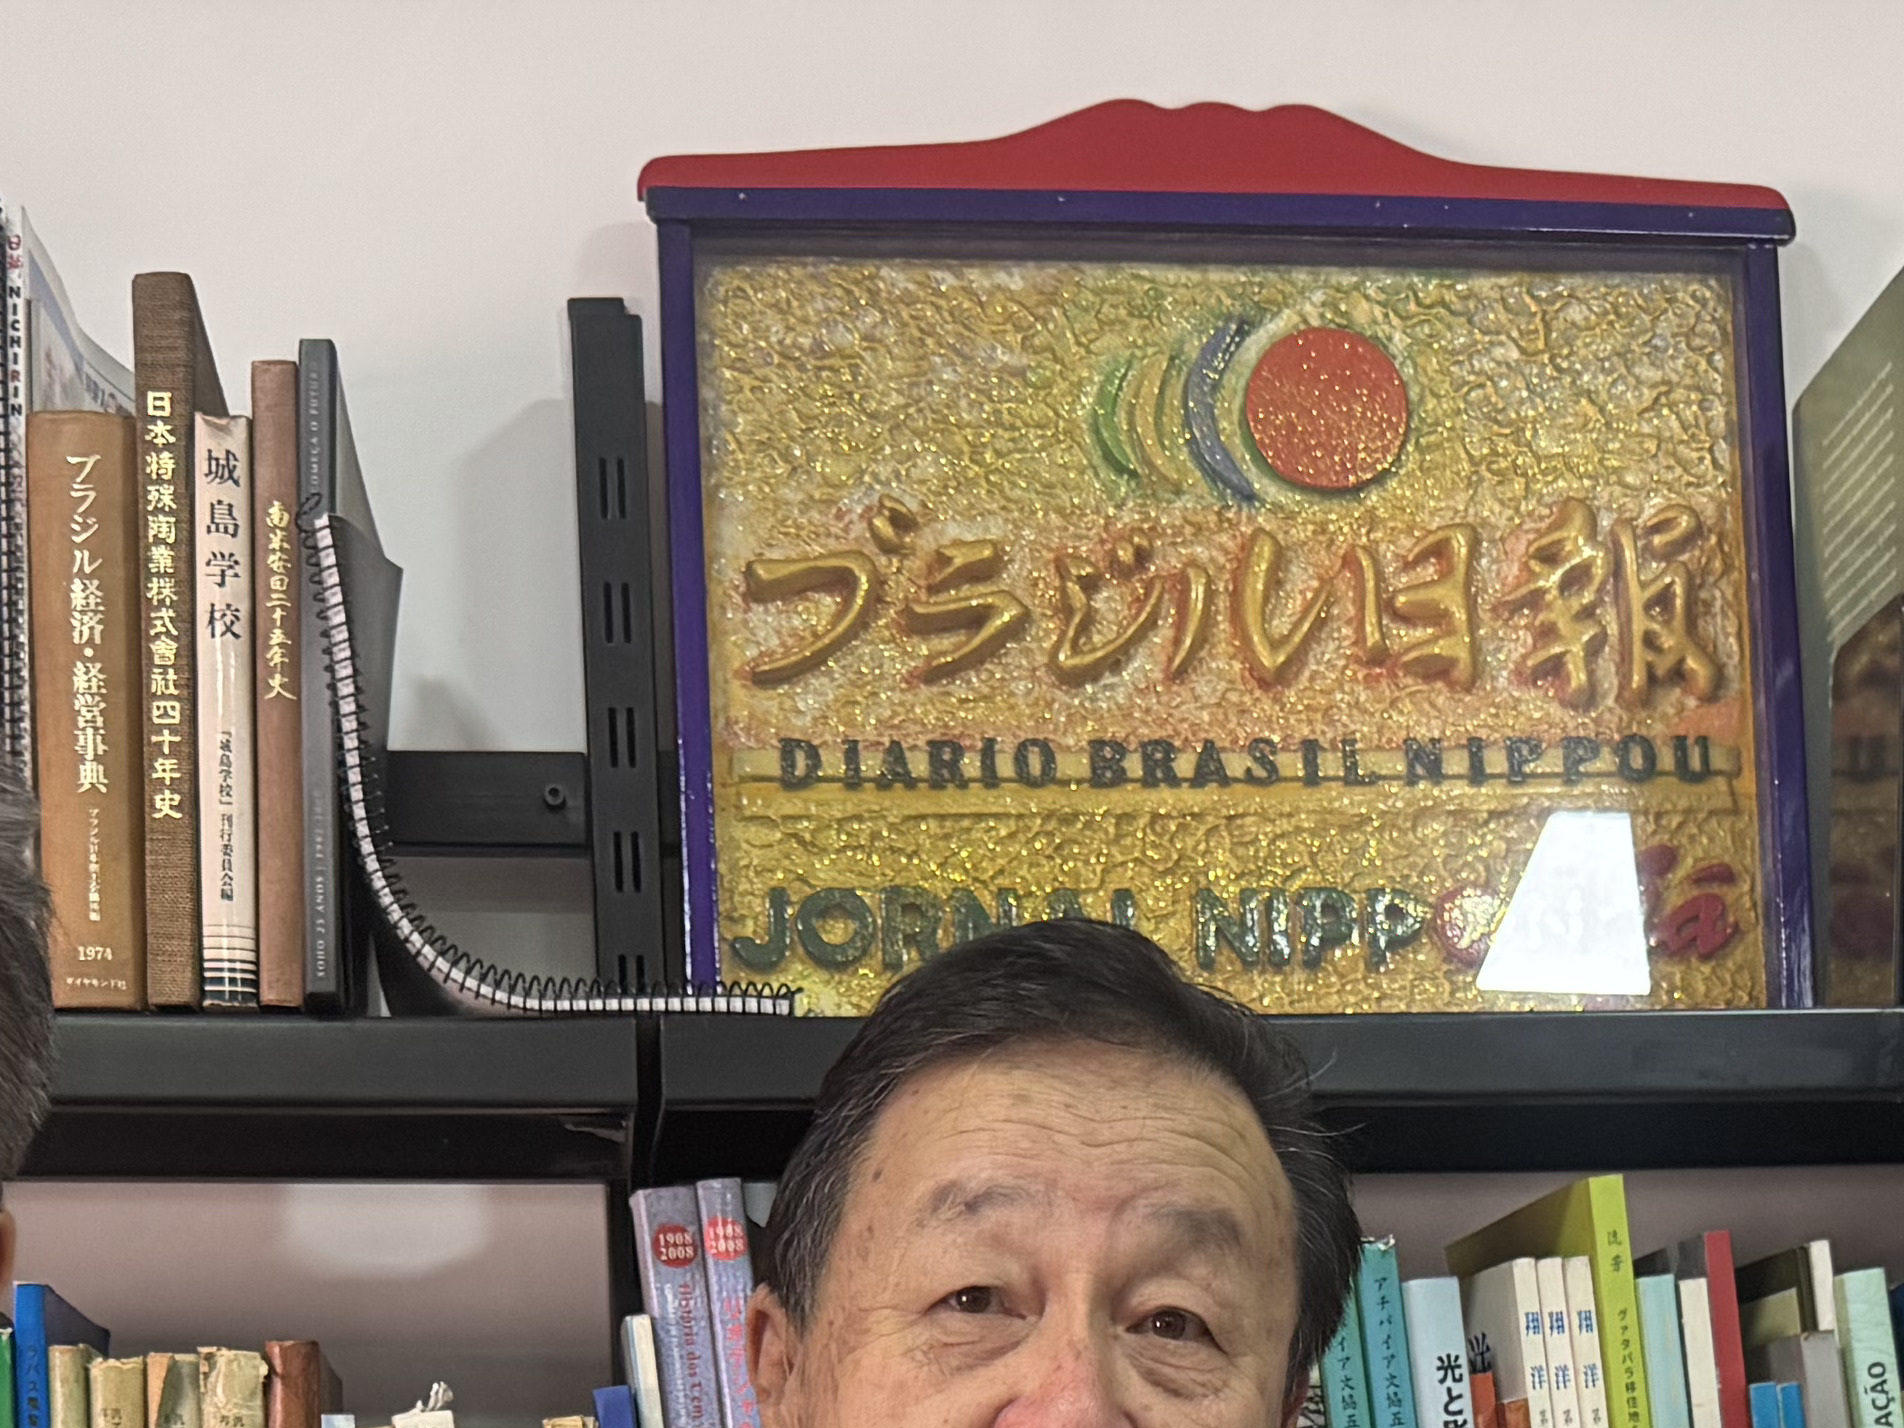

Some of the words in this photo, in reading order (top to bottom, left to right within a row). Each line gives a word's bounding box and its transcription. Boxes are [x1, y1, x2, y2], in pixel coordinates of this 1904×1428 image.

[10, 286, 22, 416] NICHIRIN
[203, 448, 242, 641] 城島学校
[66, 455, 108, 794] ブラジル経済・経営事典
[145, 391, 182, 819] 日本特殊陶業株式會社四十年史
[777, 737, 1060, 789] DIARIO
[1098, 735, 1381, 789] BRASIL
[1404, 732, 1713, 784] NIPPOU
[77, 947, 112, 960] 1974
[658, 1232, 694, 1246] 1908
[660, 1246, 695, 1261] 2008
